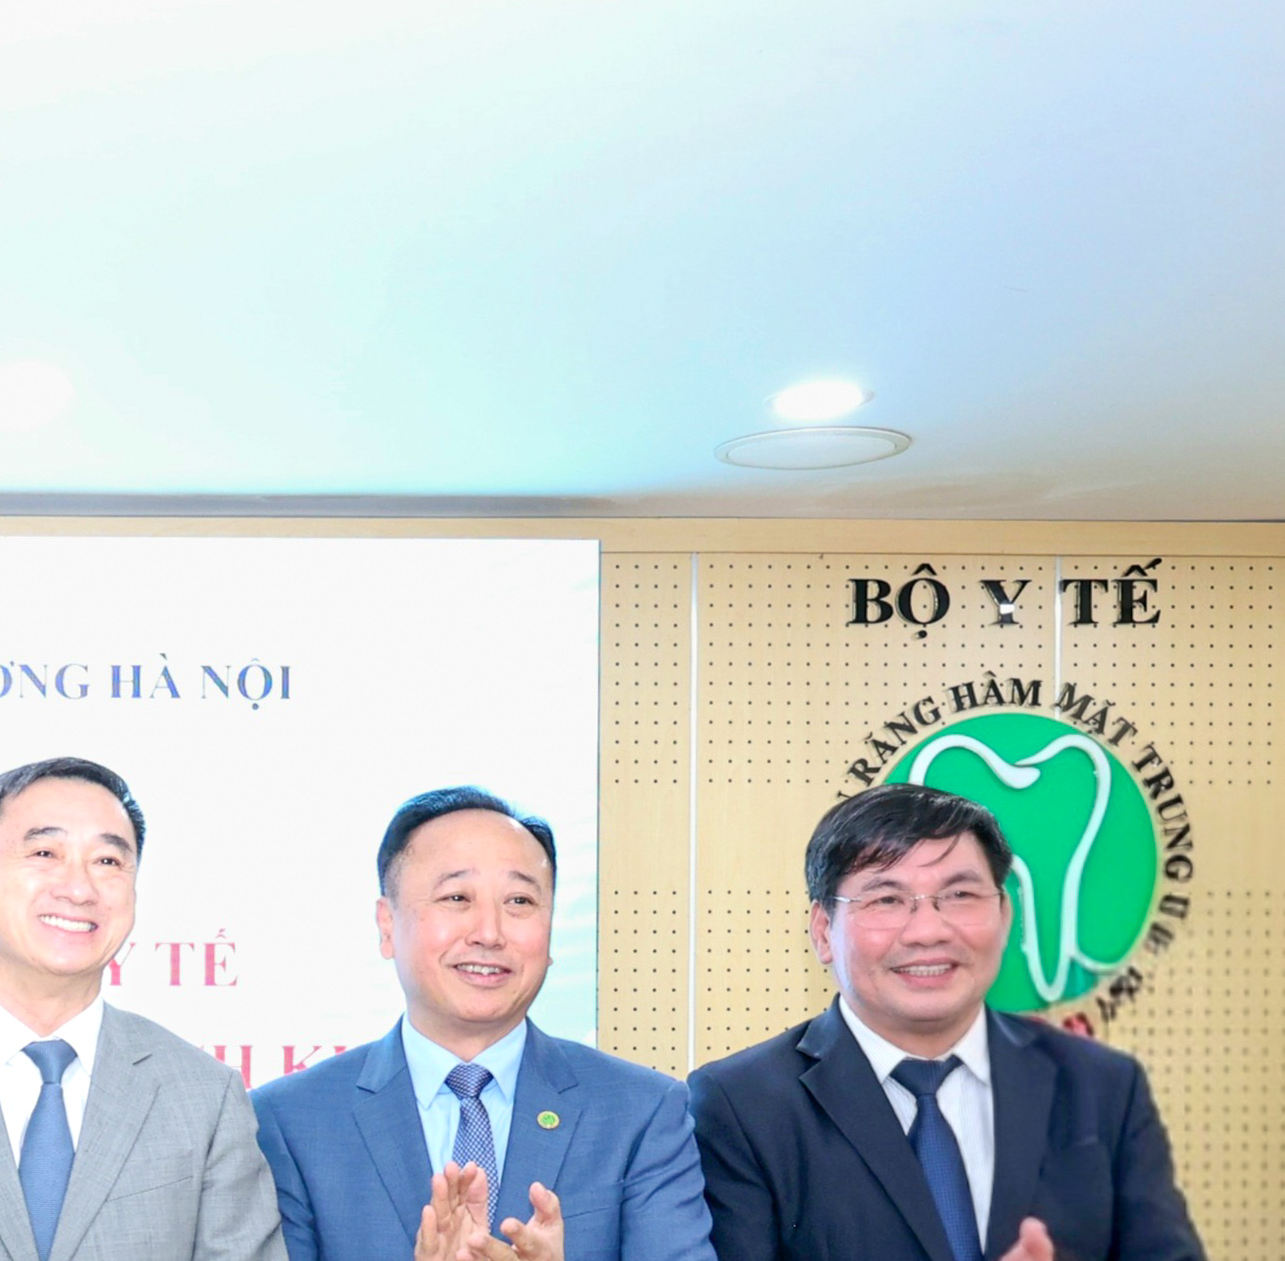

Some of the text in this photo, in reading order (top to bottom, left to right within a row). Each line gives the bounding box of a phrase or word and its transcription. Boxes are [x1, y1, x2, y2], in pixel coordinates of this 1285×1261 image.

[847, 557, 1163, 640] BỘ Y TẾ
[110, 651, 181, 700] HÀ
[200, 657, 292, 711] NỘI
[846, 695, 942, 787] RĂNG
[947, 670, 1043, 712] HÀM
[1132, 743, 1194, 884] TRUNG
[154, 928, 239, 987] TẾ
